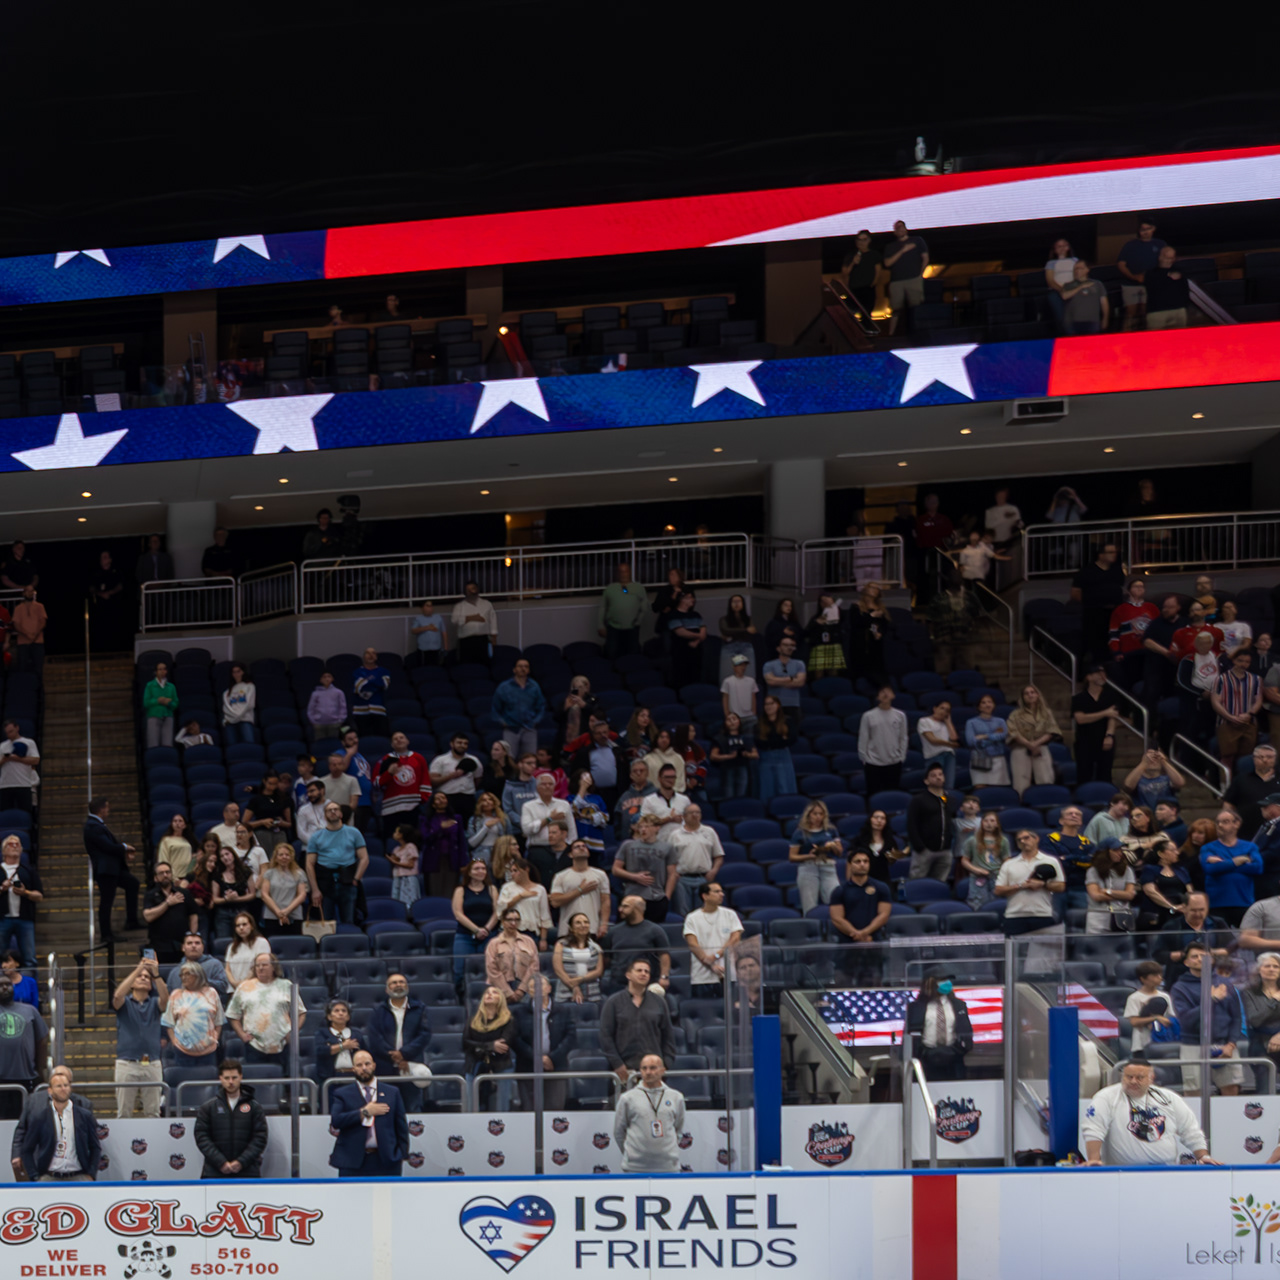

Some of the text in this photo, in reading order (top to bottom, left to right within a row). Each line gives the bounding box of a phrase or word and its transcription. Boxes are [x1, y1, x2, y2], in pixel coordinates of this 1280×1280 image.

[575, 1194, 797, 1231] ISRAEL
[105, 1199, 323, 1245] GLATT
[47, 1250, 78, 1261] WE
[217, 1248, 251, 1259] 516
[575, 1238, 798, 1269] FRIENDS
[1186, 1241, 1245, 1265] Leket
[21, 1265, 107, 1277] DELIVER
[190, 1263, 279, 1275] 530-7100
